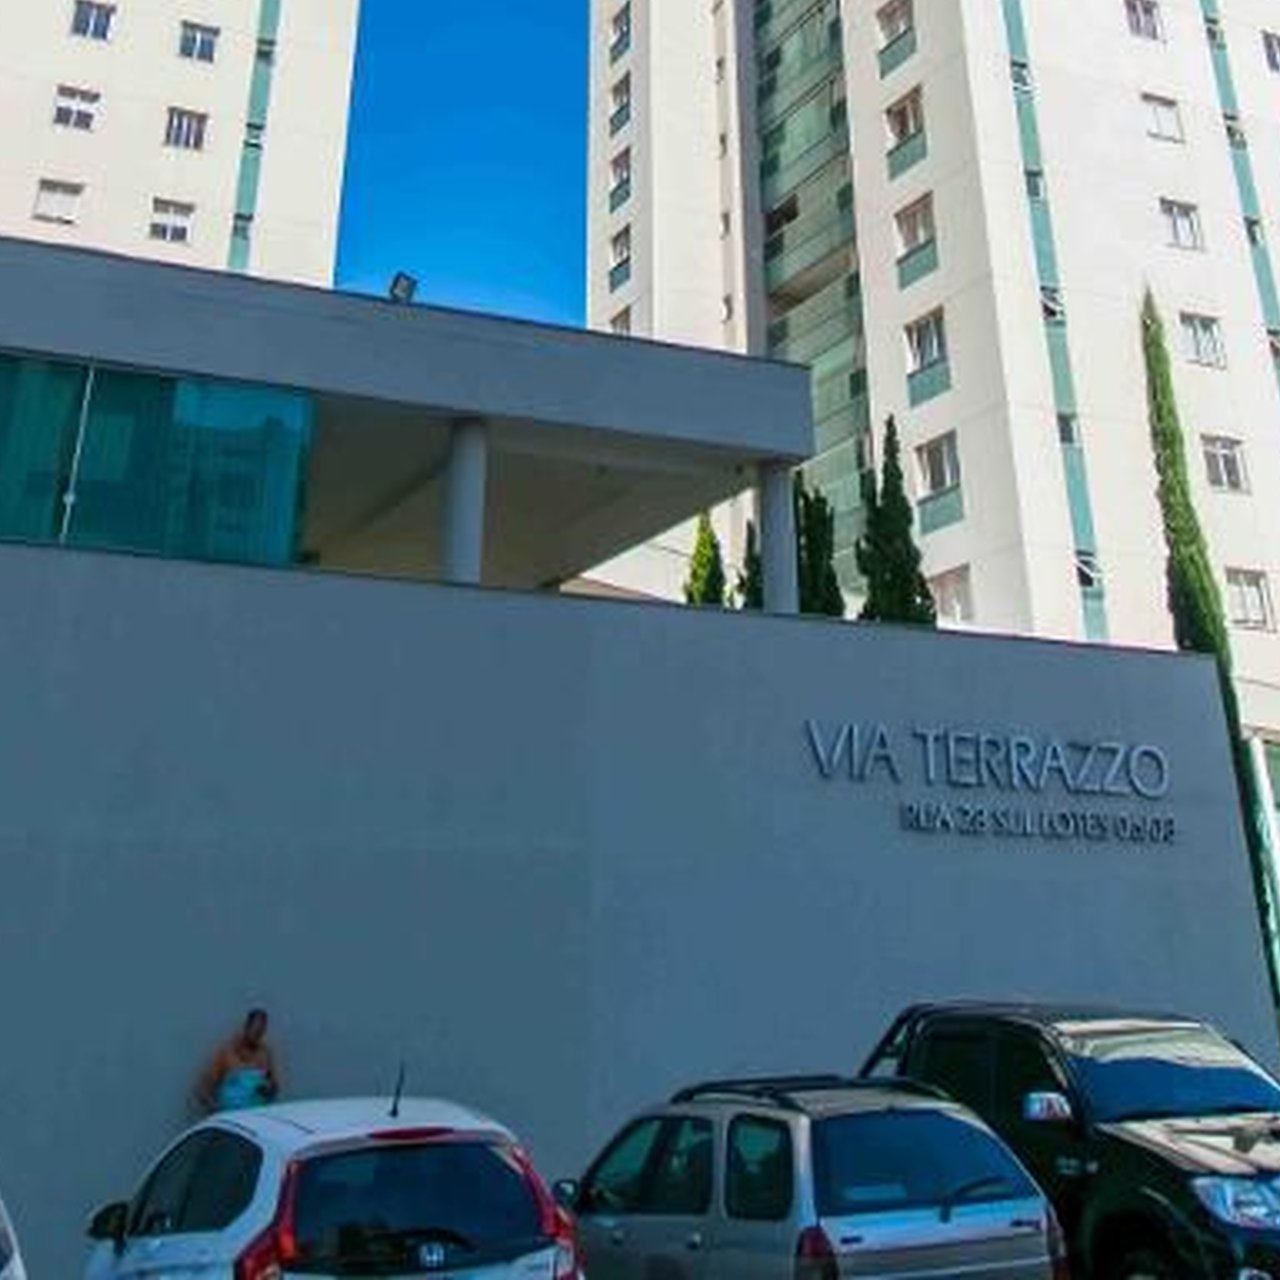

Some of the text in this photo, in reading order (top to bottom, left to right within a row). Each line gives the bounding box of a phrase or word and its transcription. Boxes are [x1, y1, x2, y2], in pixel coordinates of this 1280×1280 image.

[806, 720, 1169, 800] VIA TERRAZZO
[900, 801, 954, 833] RUA
